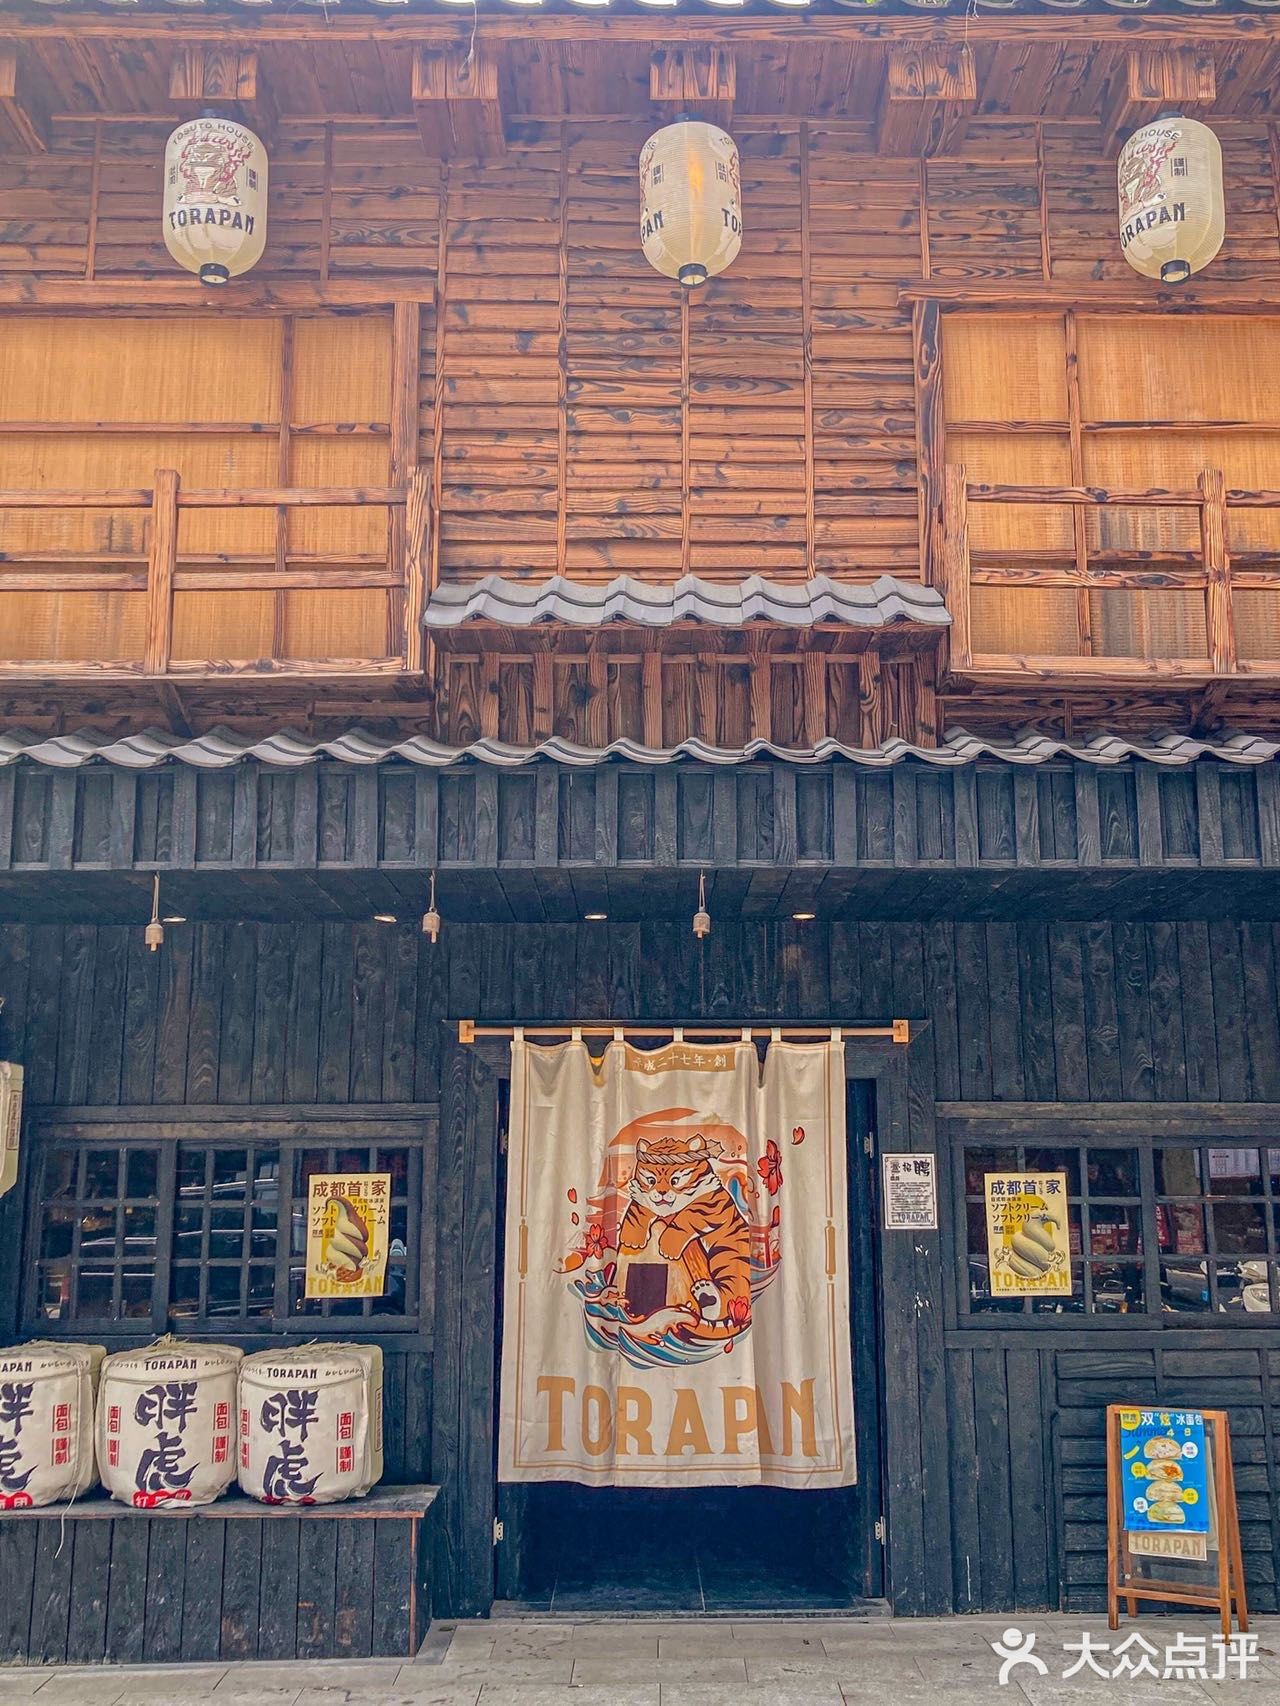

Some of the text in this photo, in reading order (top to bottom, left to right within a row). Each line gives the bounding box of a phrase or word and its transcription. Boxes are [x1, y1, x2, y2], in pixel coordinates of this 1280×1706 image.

[217, 123, 254, 151] HOUSE
[1140, 128, 1180, 141] HOUSE
[168, 207, 255, 236] TORAPAN
[990, 1179, 1061, 1196] 成都首家
[992, 1203, 1048, 1212] ソフトクリーム
[993, 1213, 1049, 1223] ソフトクリーム
[144, 1358, 197, 1371] TORAPAN
[266, 1367, 318, 1379] TORAPAN
[55, 1404, 68, 1432] 面包
[108, 1406, 119, 1433] 面包
[215, 1403, 228, 1430] 面包
[339, 1412, 352, 1440] 面包
[536, 1375, 821, 1460] TORAPAN
[1133, 1533, 1201, 1556] TORAPAN
